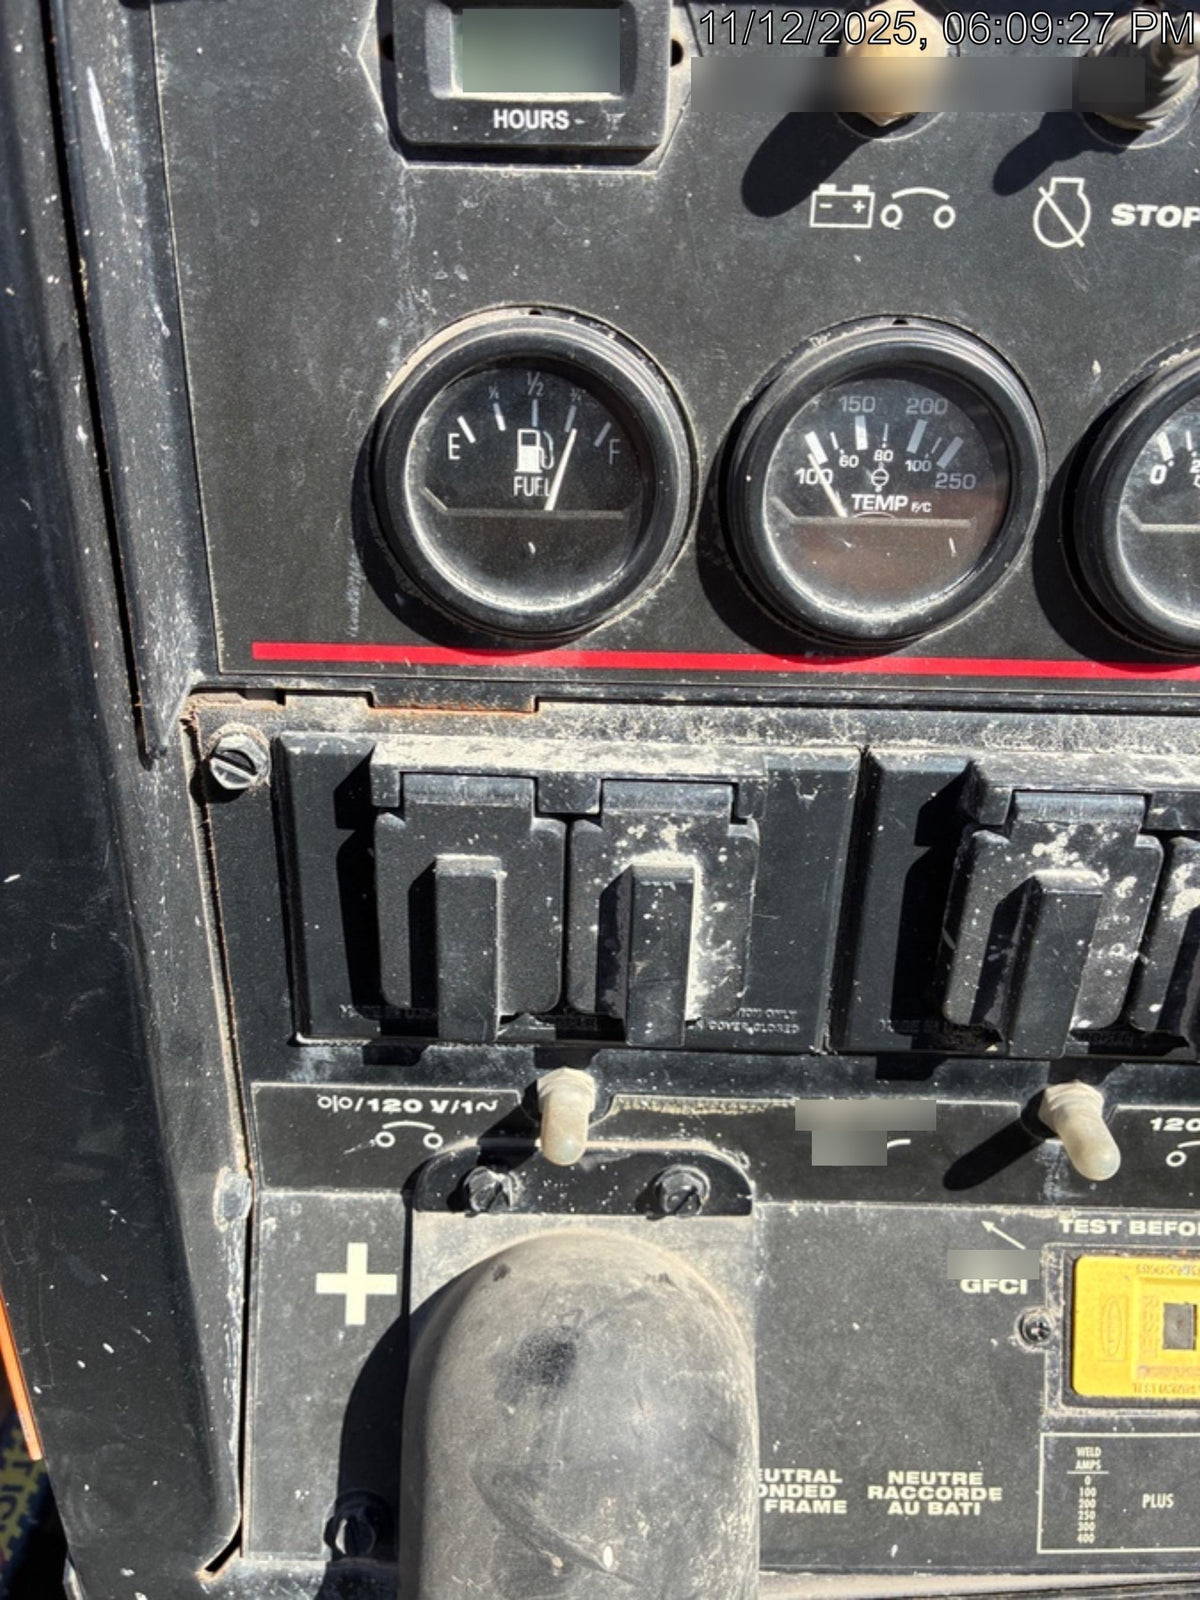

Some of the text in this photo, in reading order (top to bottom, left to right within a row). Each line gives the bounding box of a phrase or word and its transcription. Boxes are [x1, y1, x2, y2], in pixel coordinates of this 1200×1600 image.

[493, 108, 570, 130] HOURS
[1110, 203, 1200, 228] STOP
[838, 396, 876, 413] 150
[905, 397, 949, 415] 200
[447, 433, 461, 460] E
[608, 438, 621, 465] F
[839, 455, 860, 468] 60
[873, 449, 894, 462] 80
[904, 460, 932, 472] 100
[1150, 464, 1168, 485] 0
[795, 467, 833, 485] 100
[934, 473, 977, 490] 250
[513, 476, 551, 497] FUEL
[851, 494, 909, 512] TEMP
[1149, 1116, 1200, 1132] 120
[1059, 1218, 1200, 1237] TEST BEFO
[960, 1278, 1028, 1295] GFCI
[1075, 1446, 1102, 1458] WELD
[1075, 1459, 1102, 1470] AMPS
[888, 1470, 984, 1486] NEUTRE
[867, 1485, 1003, 1501] RACCORDE
[1079, 1486, 1098, 1498] 100
[1142, 1492, 1175, 1509] PLUS
[764, 1499, 848, 1514] FRAME
[887, 1501, 981, 1516] AU BATI
